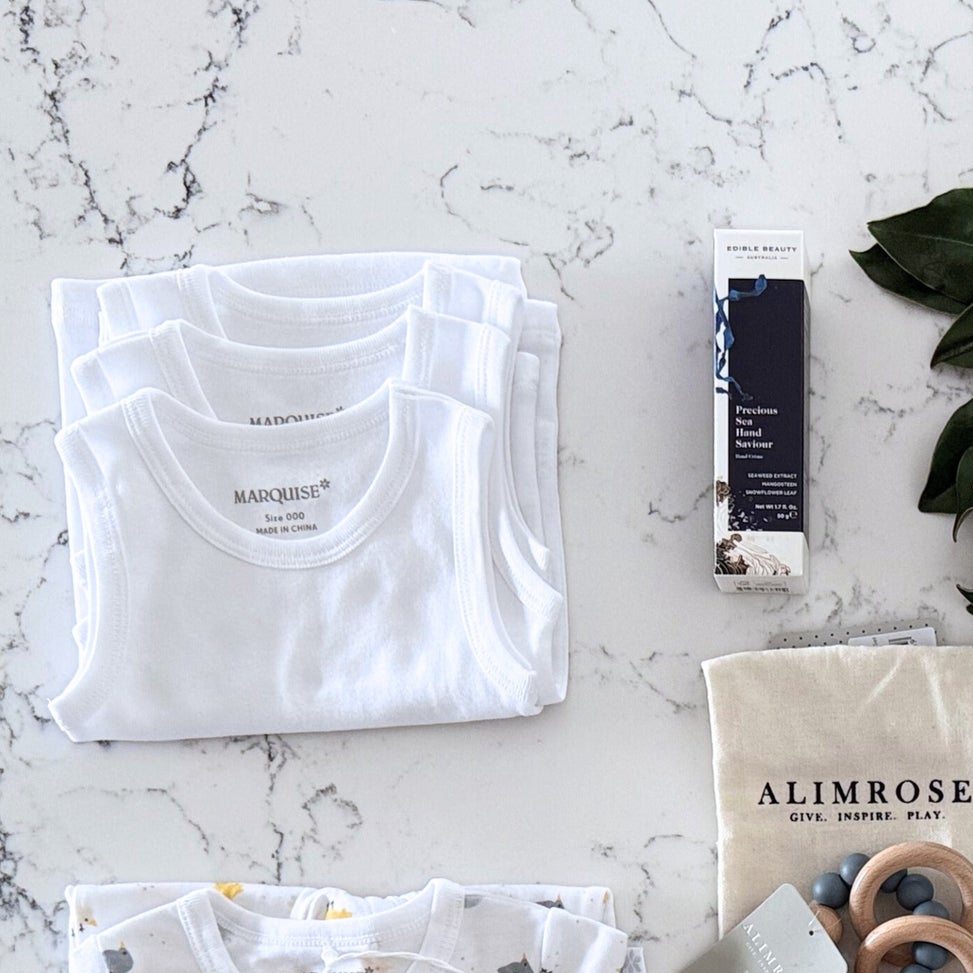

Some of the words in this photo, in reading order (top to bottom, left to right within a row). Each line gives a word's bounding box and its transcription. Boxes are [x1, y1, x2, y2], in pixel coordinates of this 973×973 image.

[736, 404, 778, 416] Precious
[736, 417, 753, 426] Sea
[736, 428, 762, 438] Hand
[736, 439, 774, 449] Saviour
[234, 484, 321, 504] MARQUISE
[265, 513, 283, 522] Size
[286, 512, 305, 520] 000
[256, 526, 278, 534] MADE
[290, 524, 318, 533] CHINA
[758, 779, 972, 805] ALIMROSE
